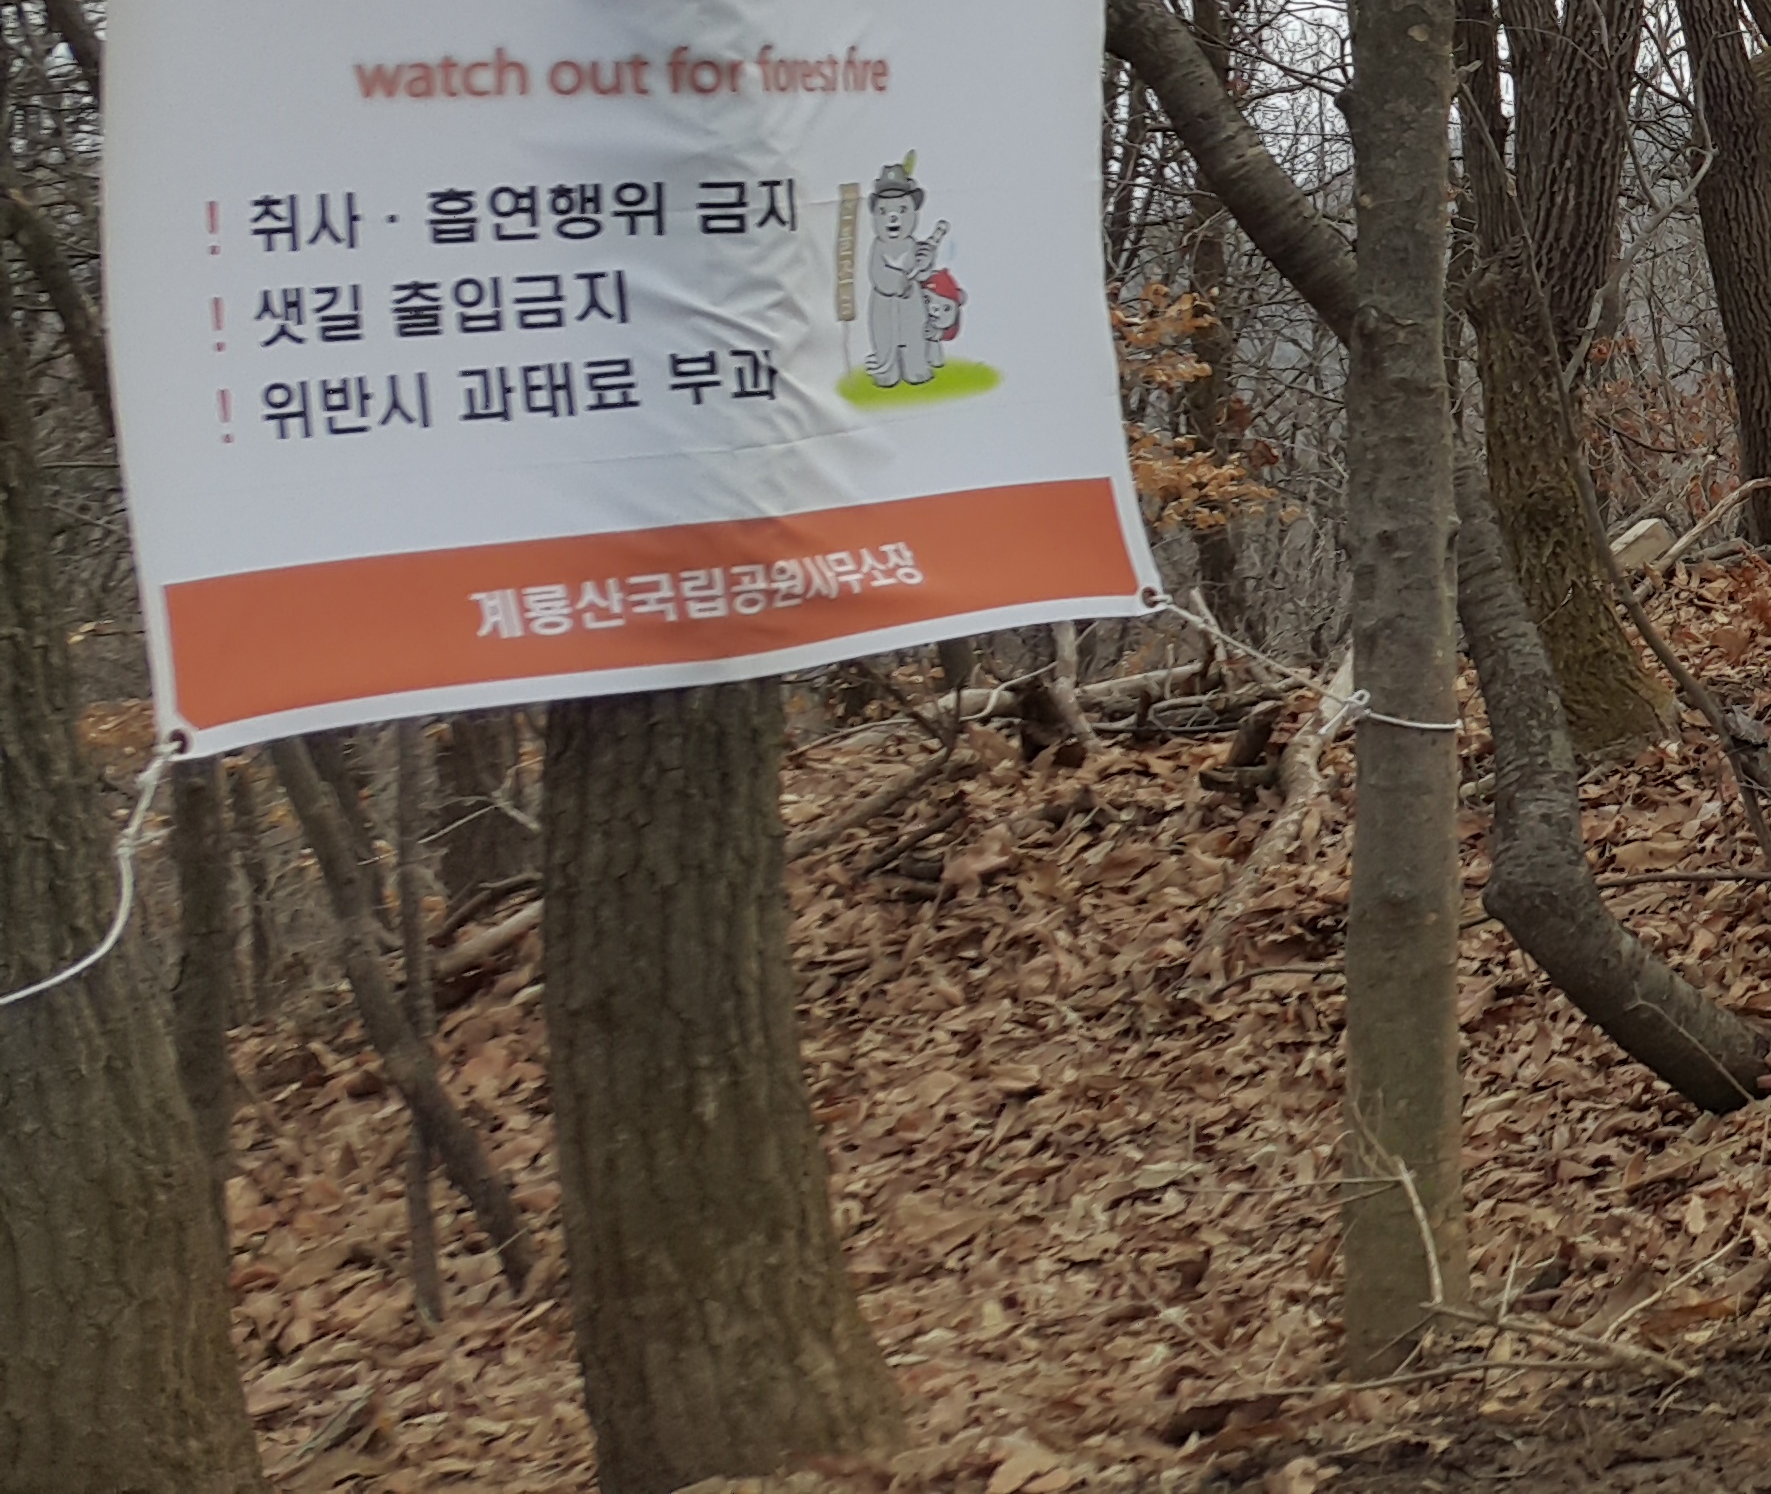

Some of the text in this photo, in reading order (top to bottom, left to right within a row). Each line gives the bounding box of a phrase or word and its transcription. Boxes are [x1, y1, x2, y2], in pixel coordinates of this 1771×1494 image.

[354, 44, 890, 99] watch out for forest fire
[248, 192, 362, 253] 취사
[426, 180, 667, 245] 흡연행위
[694, 177, 799, 236] 금지
[253, 283, 363, 348] 샛길
[389, 269, 629, 339] 출입금지
[261, 371, 432, 441] 위반시
[457, 356, 641, 424] 과태료
[668, 348, 779, 407] 부과
